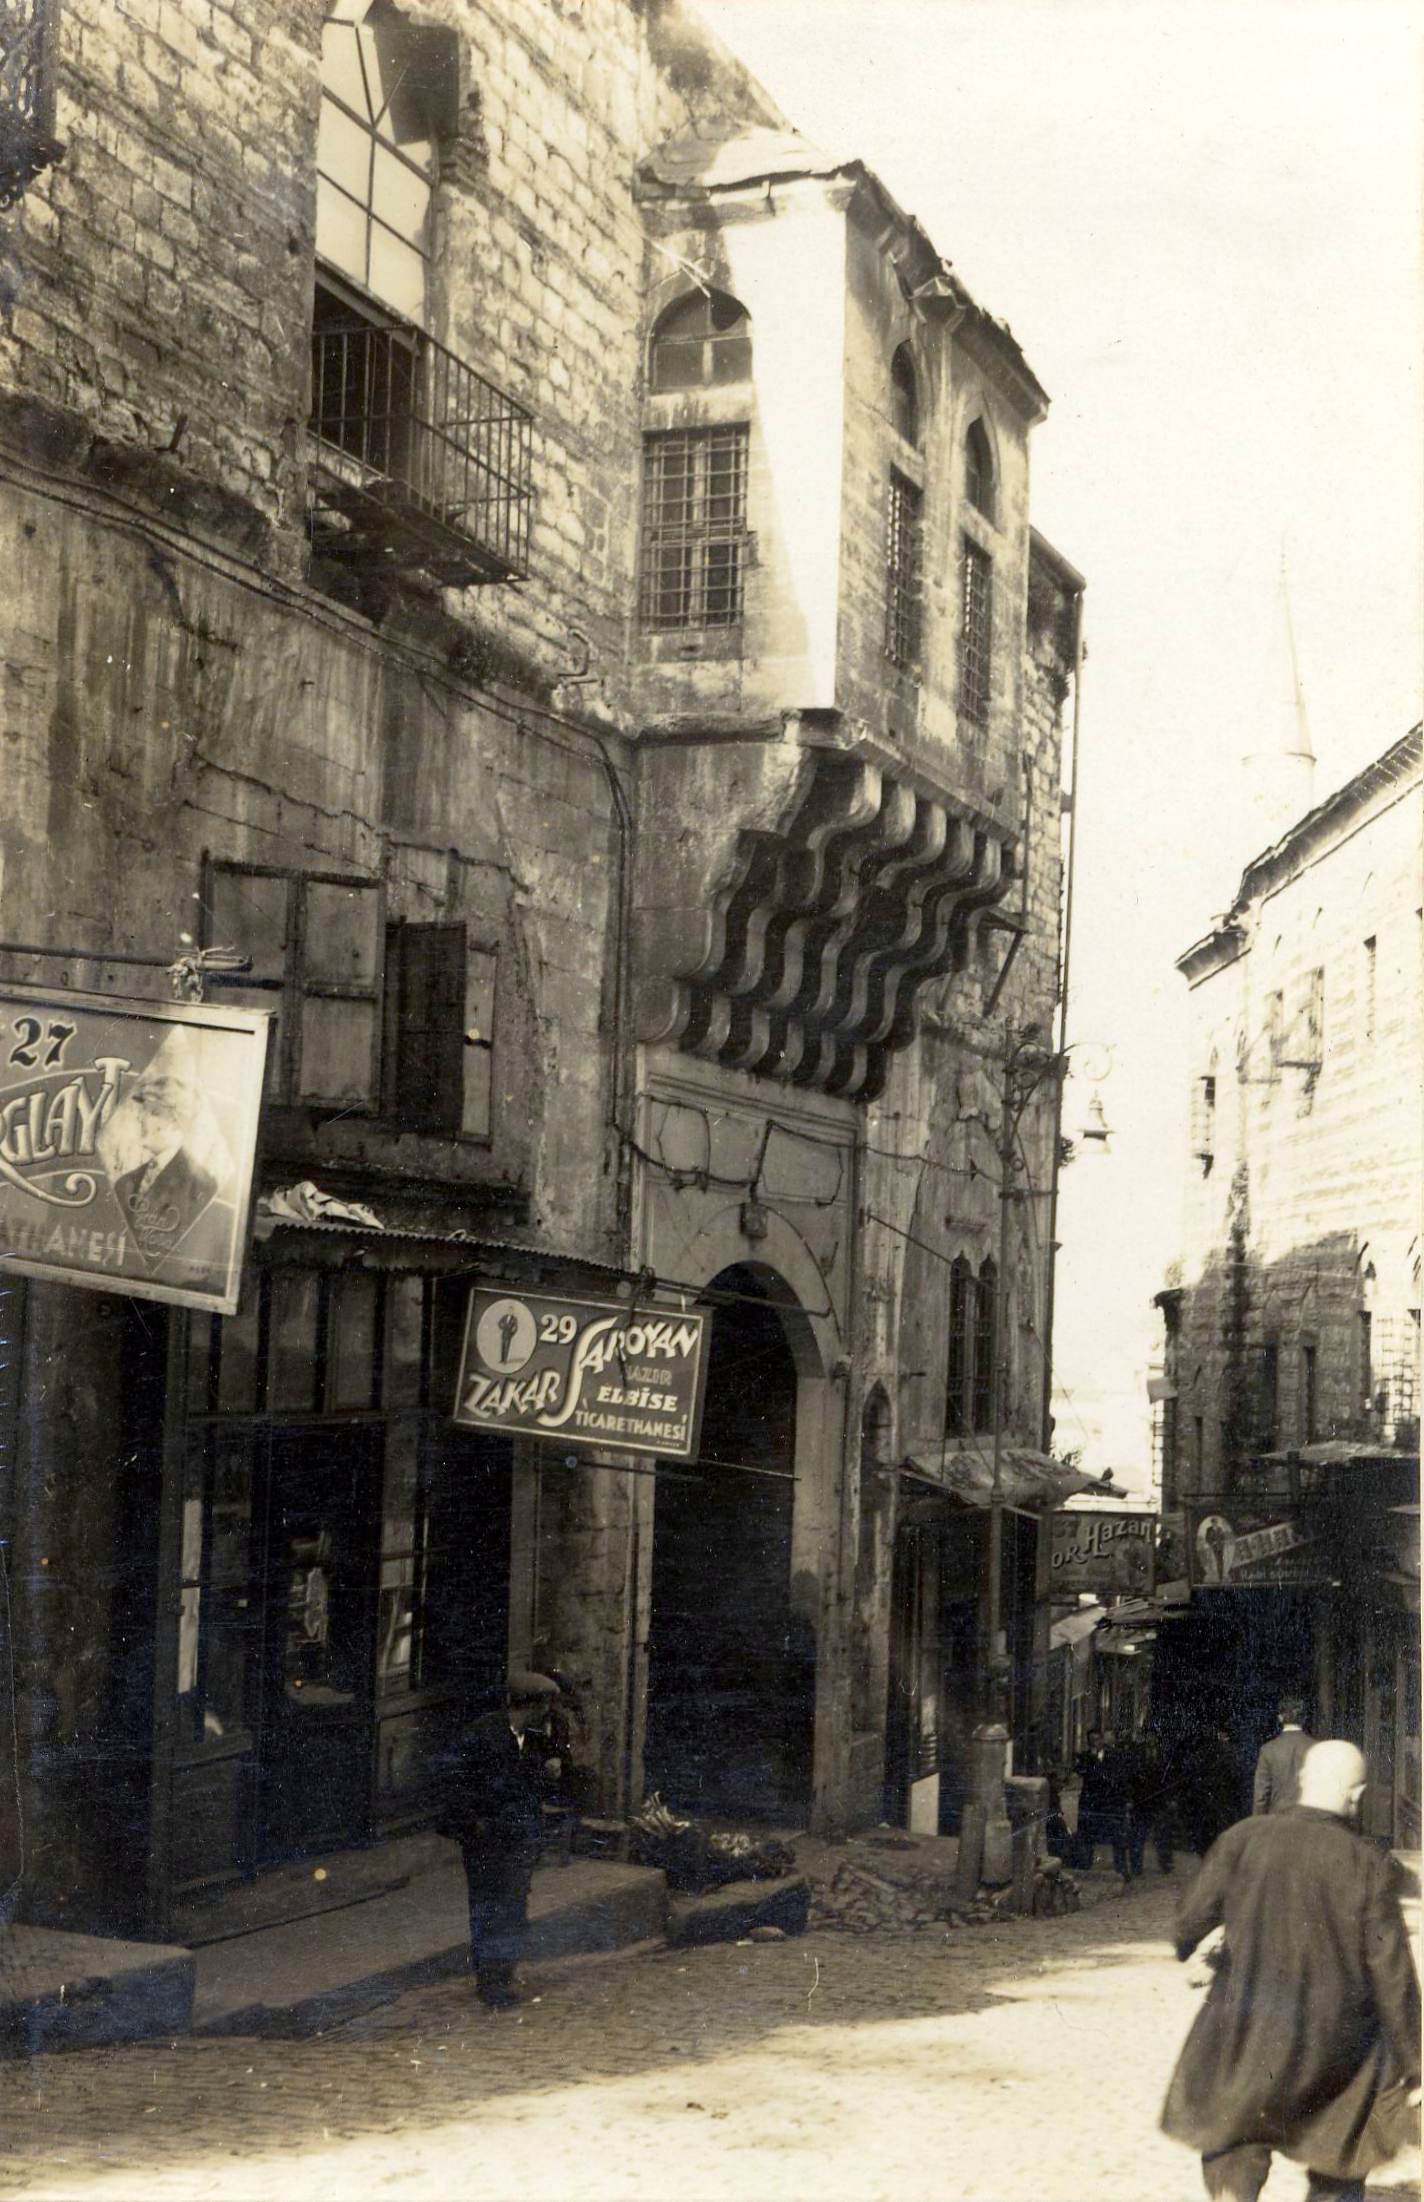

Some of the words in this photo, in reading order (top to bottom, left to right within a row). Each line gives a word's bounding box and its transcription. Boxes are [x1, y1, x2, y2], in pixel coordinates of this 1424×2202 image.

[9, 1016, 78, 1071] 27
[0, 1056, 131, 1166] GLAYT
[539, 1313, 578, 1345] 29
[464, 1370, 561, 1419] ZAKAR
[536, 1315, 699, 1427] SAROYAN
[597, 1384, 678, 1412] ELBİSE
